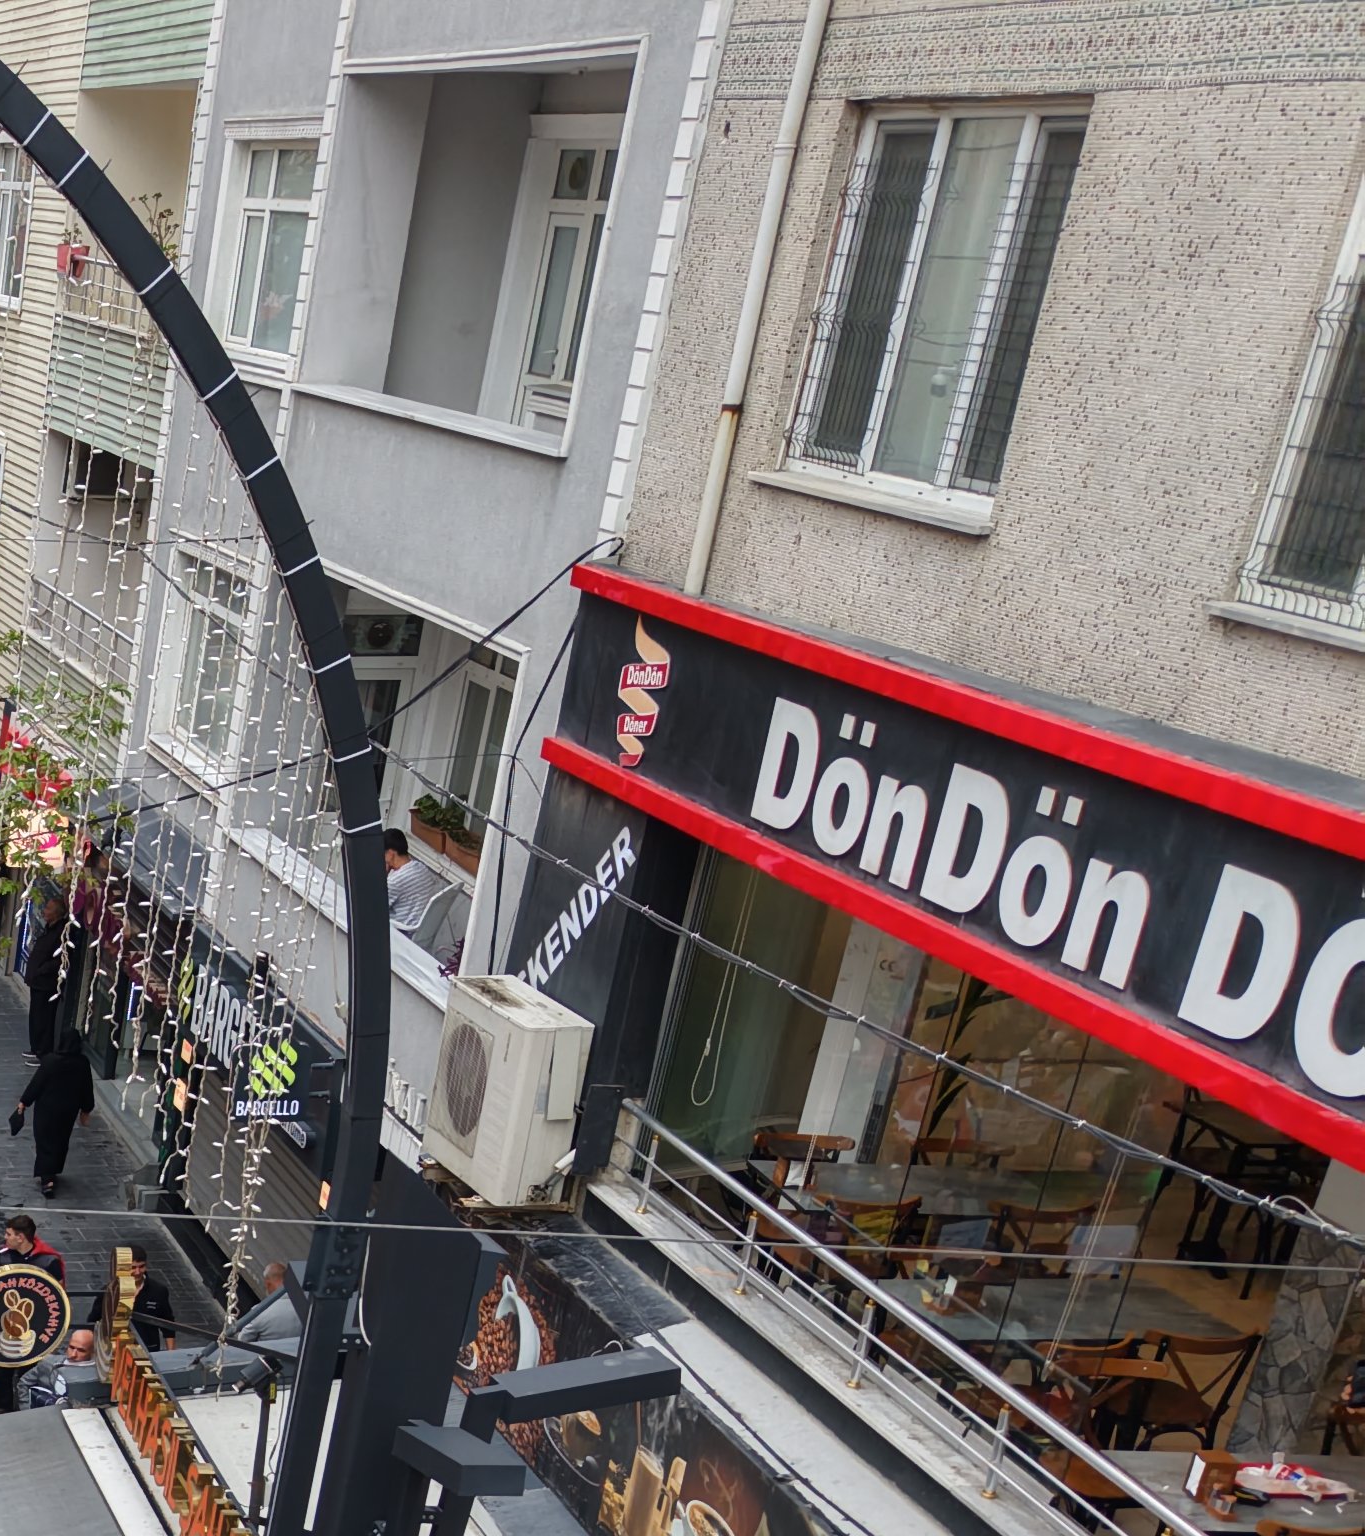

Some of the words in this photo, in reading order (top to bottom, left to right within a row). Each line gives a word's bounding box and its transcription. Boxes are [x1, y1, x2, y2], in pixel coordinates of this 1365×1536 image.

[626, 664, 664, 686] DönDön
[622, 714, 648, 734] Döner
[750, 695, 1151, 991] DönDön
[515, 825, 639, 990] KENDER
